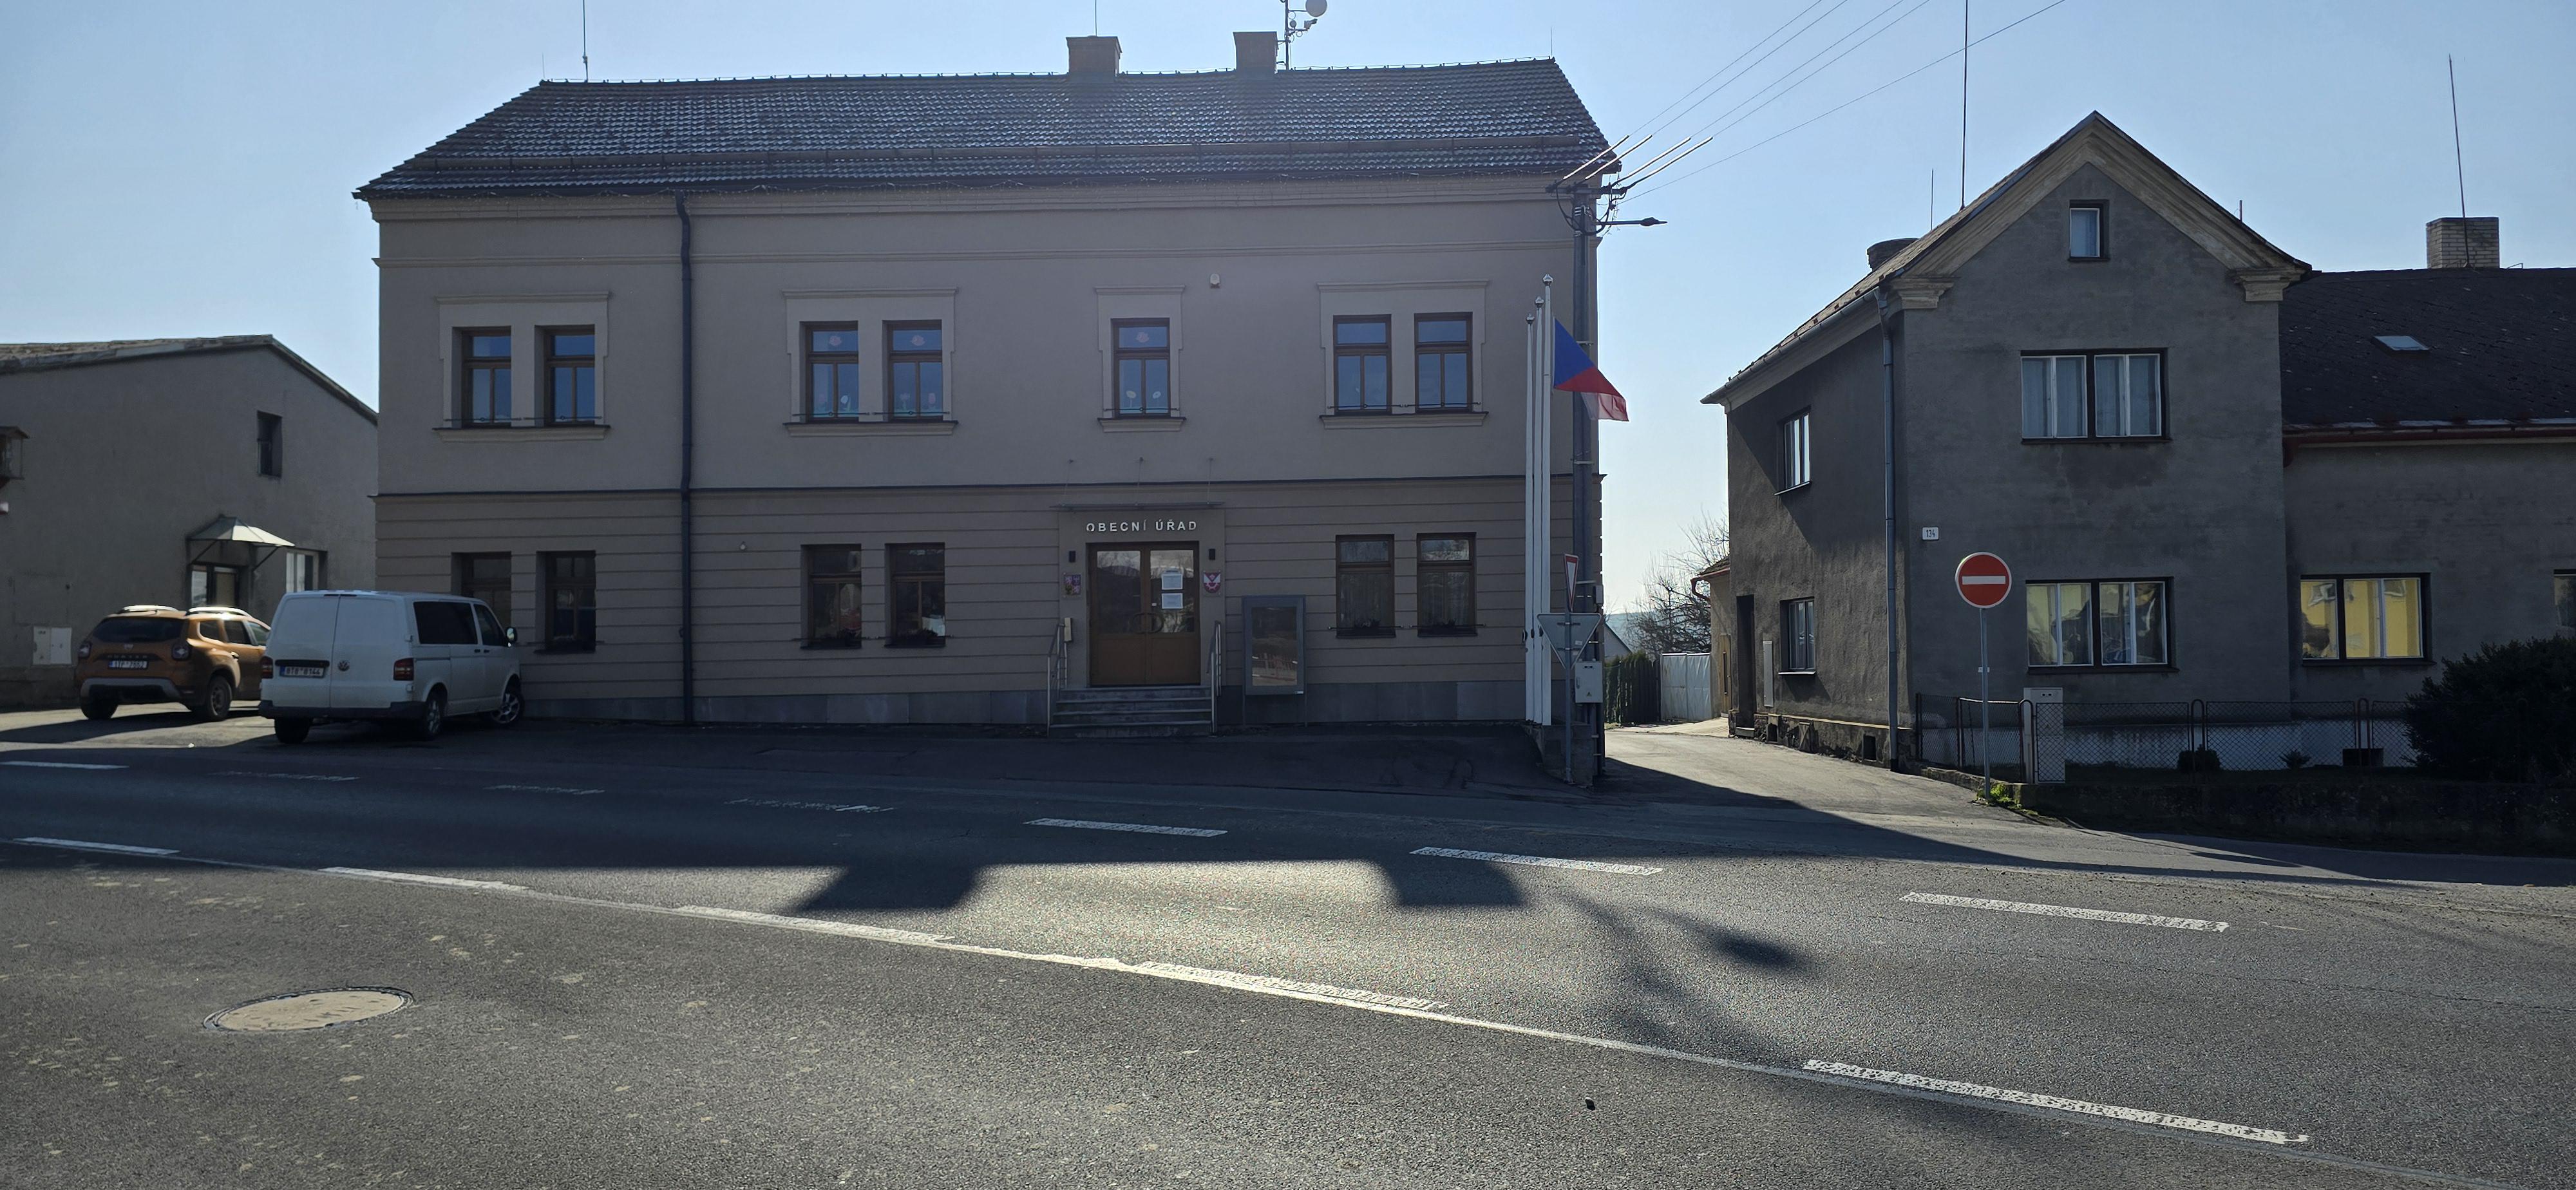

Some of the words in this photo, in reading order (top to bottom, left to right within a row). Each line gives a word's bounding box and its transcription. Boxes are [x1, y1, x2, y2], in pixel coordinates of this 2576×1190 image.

[1086, 519, 1147, 532] OBECNÍ
[1155, 518, 1197, 531] ÚŘAD
[1926, 529, 1935, 538] 134
